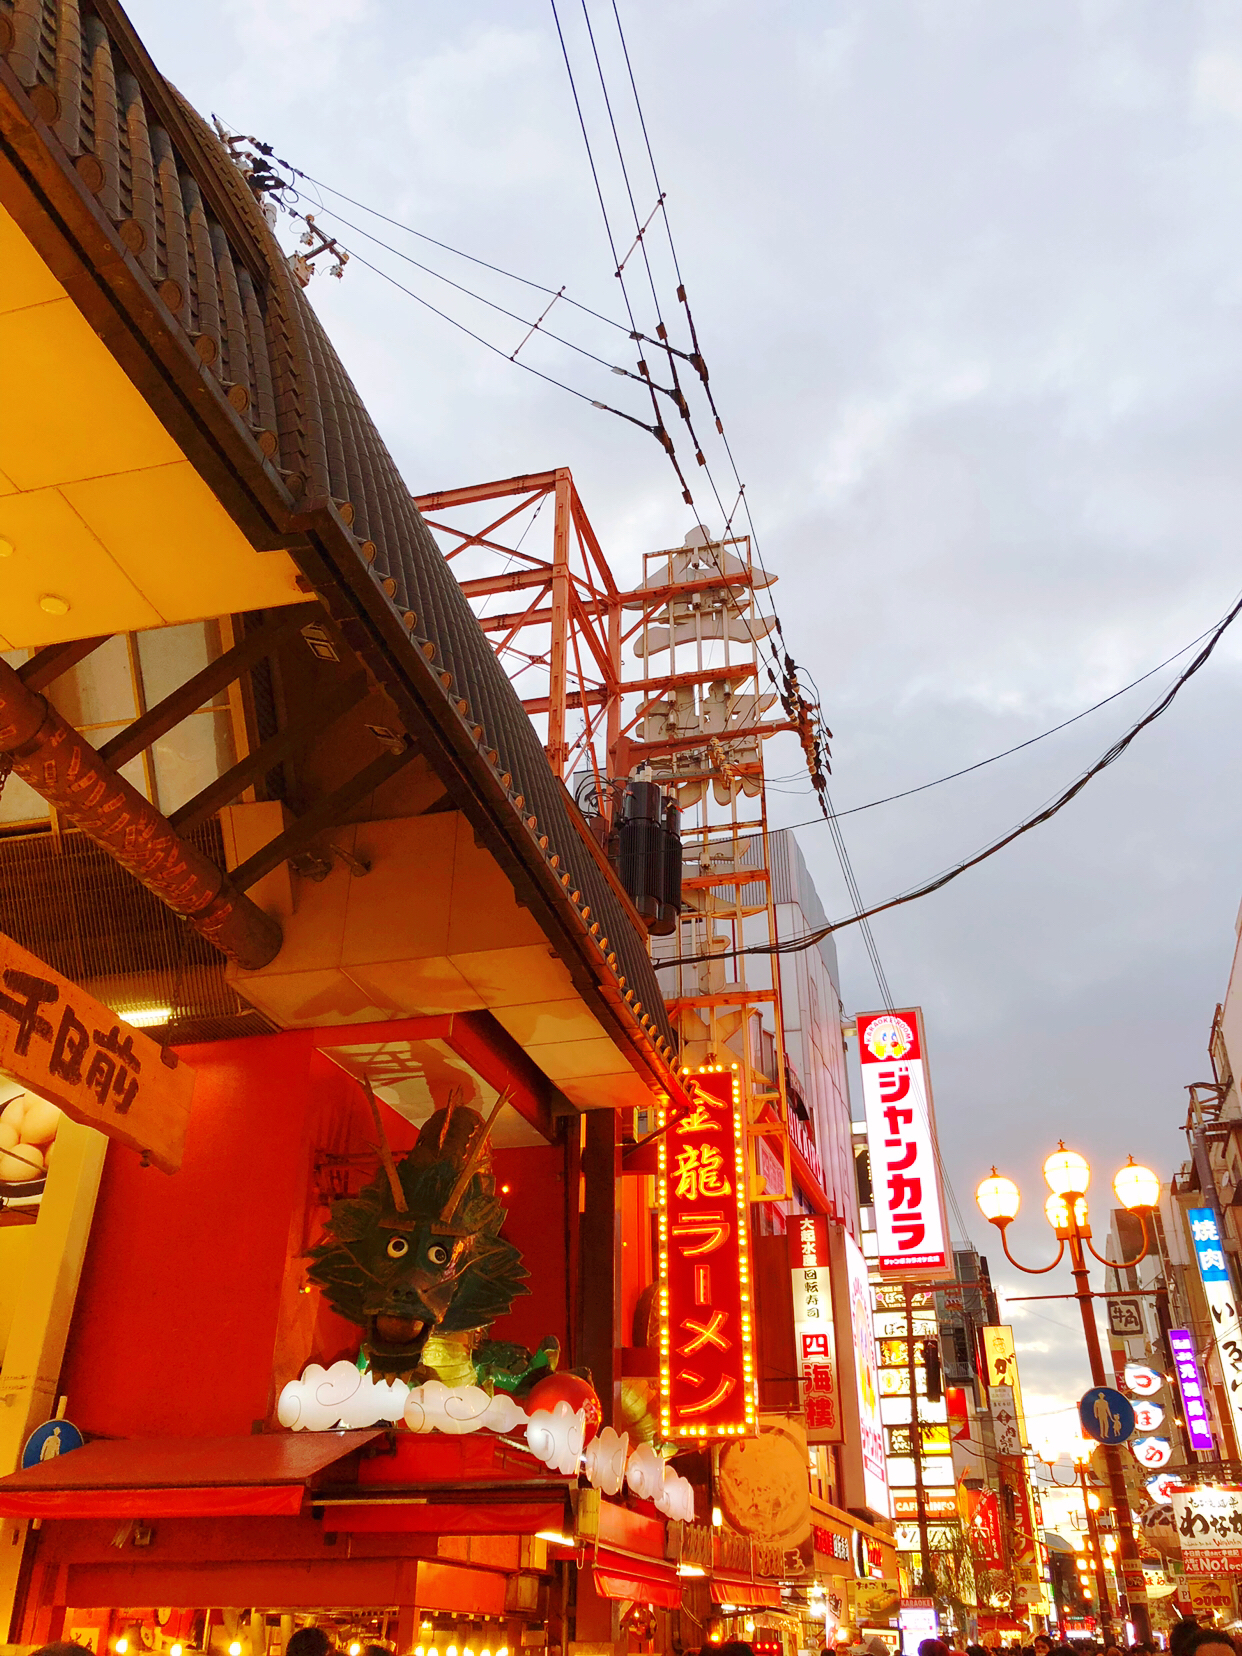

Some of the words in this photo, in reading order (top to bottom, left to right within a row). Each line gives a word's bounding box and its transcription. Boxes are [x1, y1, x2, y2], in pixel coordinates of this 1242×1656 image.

[0, 969, 141, 1115] 千日前
[866, 1017, 893, 1042] KARAOKE
[895, 1019, 911, 1040] ROOM
[878, 1067, 926, 1250] ジャンカラ
[672, 1080, 737, 1418] 金龍ラーメン
[800, 1218, 817, 1267] 大起水産
[1192, 1219, 1226, 1271] 焼肉
[804, 1270, 819, 1318] 回転寿司
[1112, 1306, 1139, 1327] 牛角
